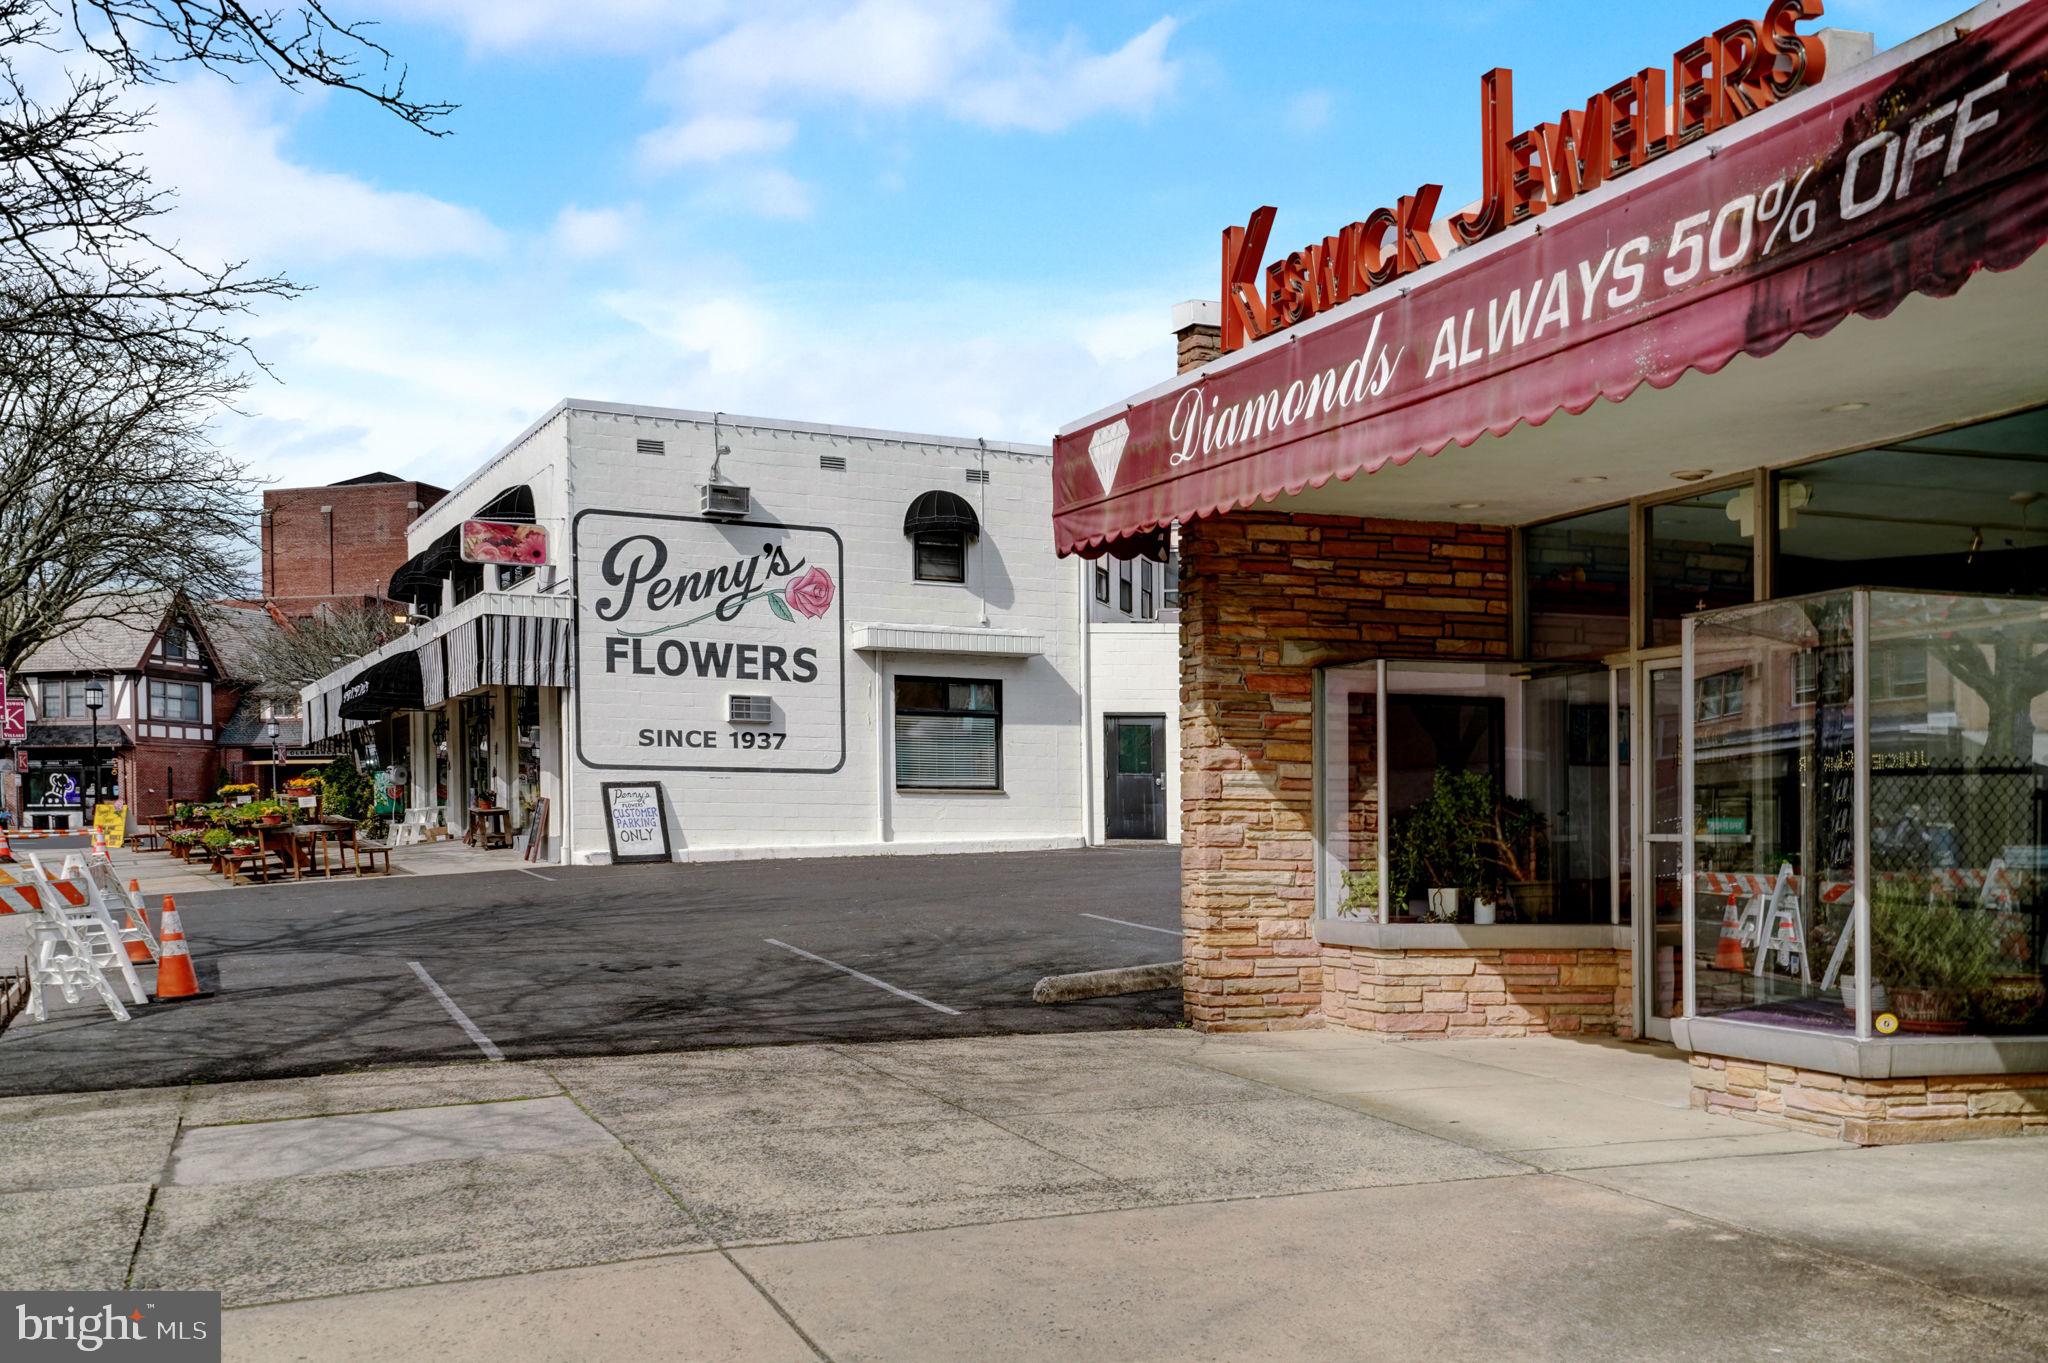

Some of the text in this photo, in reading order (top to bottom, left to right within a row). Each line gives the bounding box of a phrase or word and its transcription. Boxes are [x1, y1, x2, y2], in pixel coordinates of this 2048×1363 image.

[1221, 0, 1827, 353] KESWICK JEWELERS
[1169, 72, 2009, 467] Diamonds ALWAYS 50% OFF
[595, 534, 805, 622] Penny's
[605, 637, 818, 683] FLOWERS
[638, 729, 787, 750] SINCE 1937
[614, 789, 650, 805] Penny's
[613, 807, 658, 819] CUSTOMER
[616, 818, 656, 828] PARKING
[621, 828, 653, 842] ONLY
